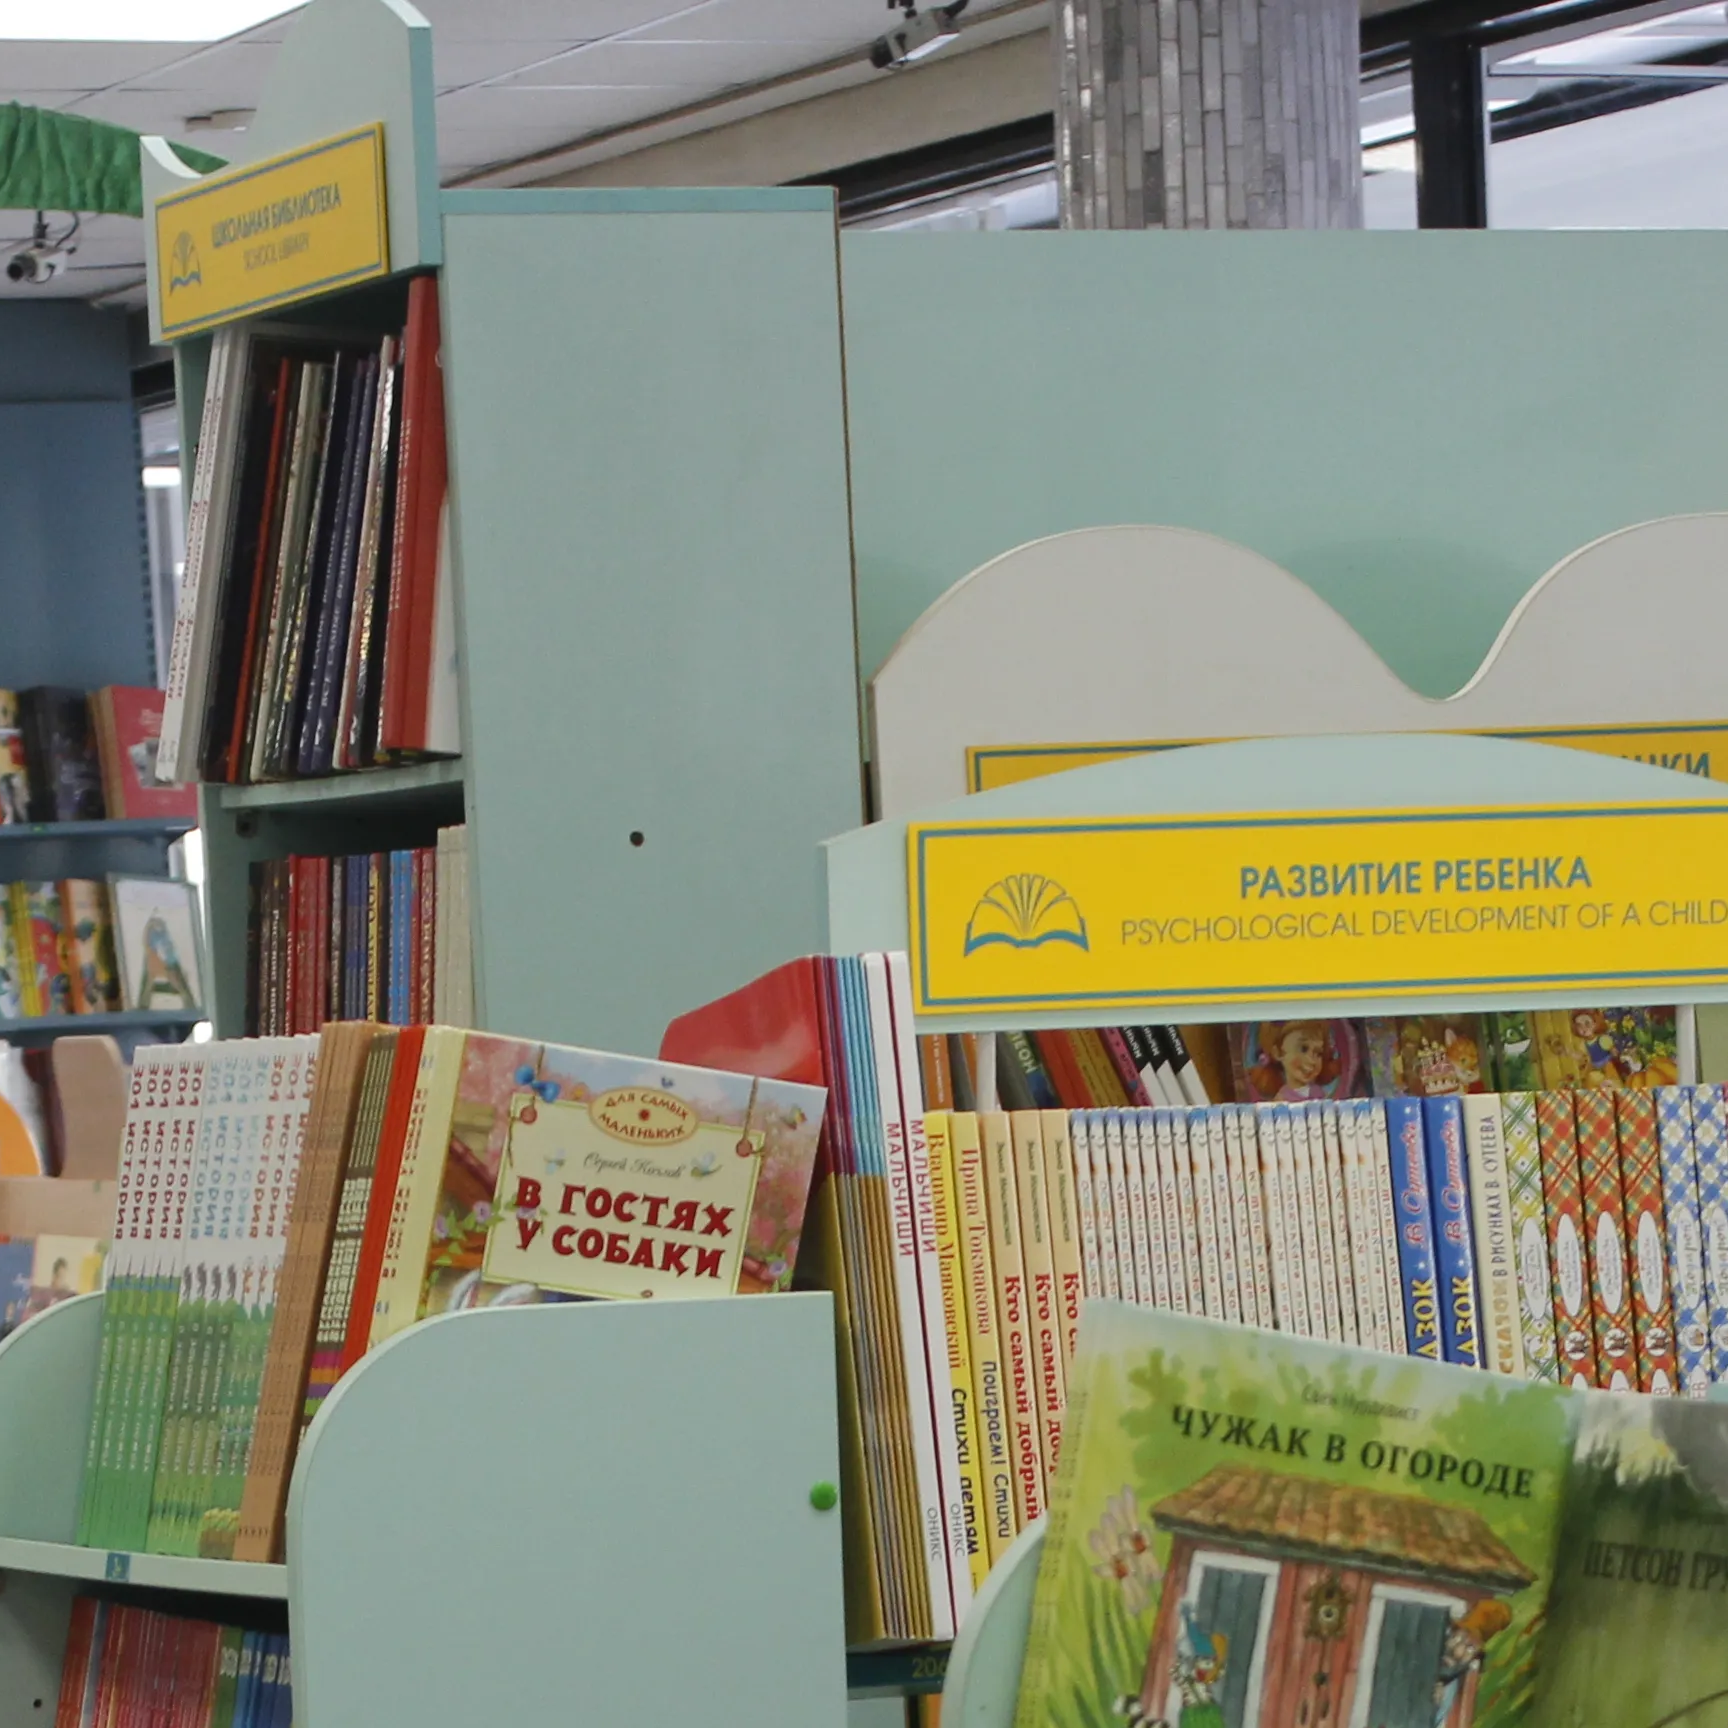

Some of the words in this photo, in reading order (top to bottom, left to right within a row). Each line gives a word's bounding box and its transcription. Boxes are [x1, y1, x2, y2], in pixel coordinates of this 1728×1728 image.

[211, 209, 271, 249] ШКОЛЬНАЯ
[272, 183, 342, 229] БИБЛИОТЕКА
[1238, 860, 1423, 901] РАЗВИТИЕ
[1433, 855, 1593, 894] РЕБЕНКА
[1119, 910, 1365, 947] PSYCHOLOGICAL
[1370, 902, 1571, 937] DEVELOPMENT
[1577, 902, 1613, 930] OF
[1620, 902, 1643, 927] A
[130, 1066, 144, 1109] 301
[145, 1062, 160, 1107] 301
[159, 1063, 173, 1108] 301
[175, 1059, 190, 1106] 301
[190, 1059, 204, 1107] 301
[268, 1054, 286, 1102] 301
[286, 1052, 302, 1100] 301
[604, 1091, 636, 1109] ДЛЯ
[639, 1090, 690, 1122] САМЫХ
[597, 1111, 687, 1140] МАЛЕНЬКИХ
[1479, 1114, 1500, 1175] СУТЕЕВА
[515, 1176, 543, 1210] В
[558, 1182, 735, 1239] ГОСТЯХ
[928, 1132, 949, 1235] Владимир
[960, 1148, 980, 1217] Ирина
[515, 1218, 542, 1252] У
[551, 1224, 726, 1280] СОБАКИ
[1484, 1193, 1507, 1263] РИСУНКАХ
[937, 1241, 964, 1368] Маяковский
[967, 1220, 992, 1335] Токмакова
[1003, 1274, 1021, 1324] Кто
[1034, 1272, 1051, 1322] Кто
[885, 1122, 914, 1256] МАЛЬЧИШИ
[926, 1506, 943, 1562] ОНИКС
[909, 1119, 937, 1252] МАЛЬЧИШИ
[949, 1502, 967, 1558] ОНИКС
[1010, 1331, 1028, 1415] самый
[1039, 1329, 1060, 1413] самый
[950, 1387, 970, 1465] Стихи
[979, 1360, 1008, 1465] Поиграем!
[1016, 1420, 1039, 1521] добрый
[1169, 1402, 1310, 1461] ЧУЖАК
[1323, 1433, 1347, 1465] В
[1361, 1439, 1535, 1501] ОГОРОДЕ
[991, 1472, 1011, 1539] Стихи
[1582, 1538, 1683, 1592] ПЕТСОН
